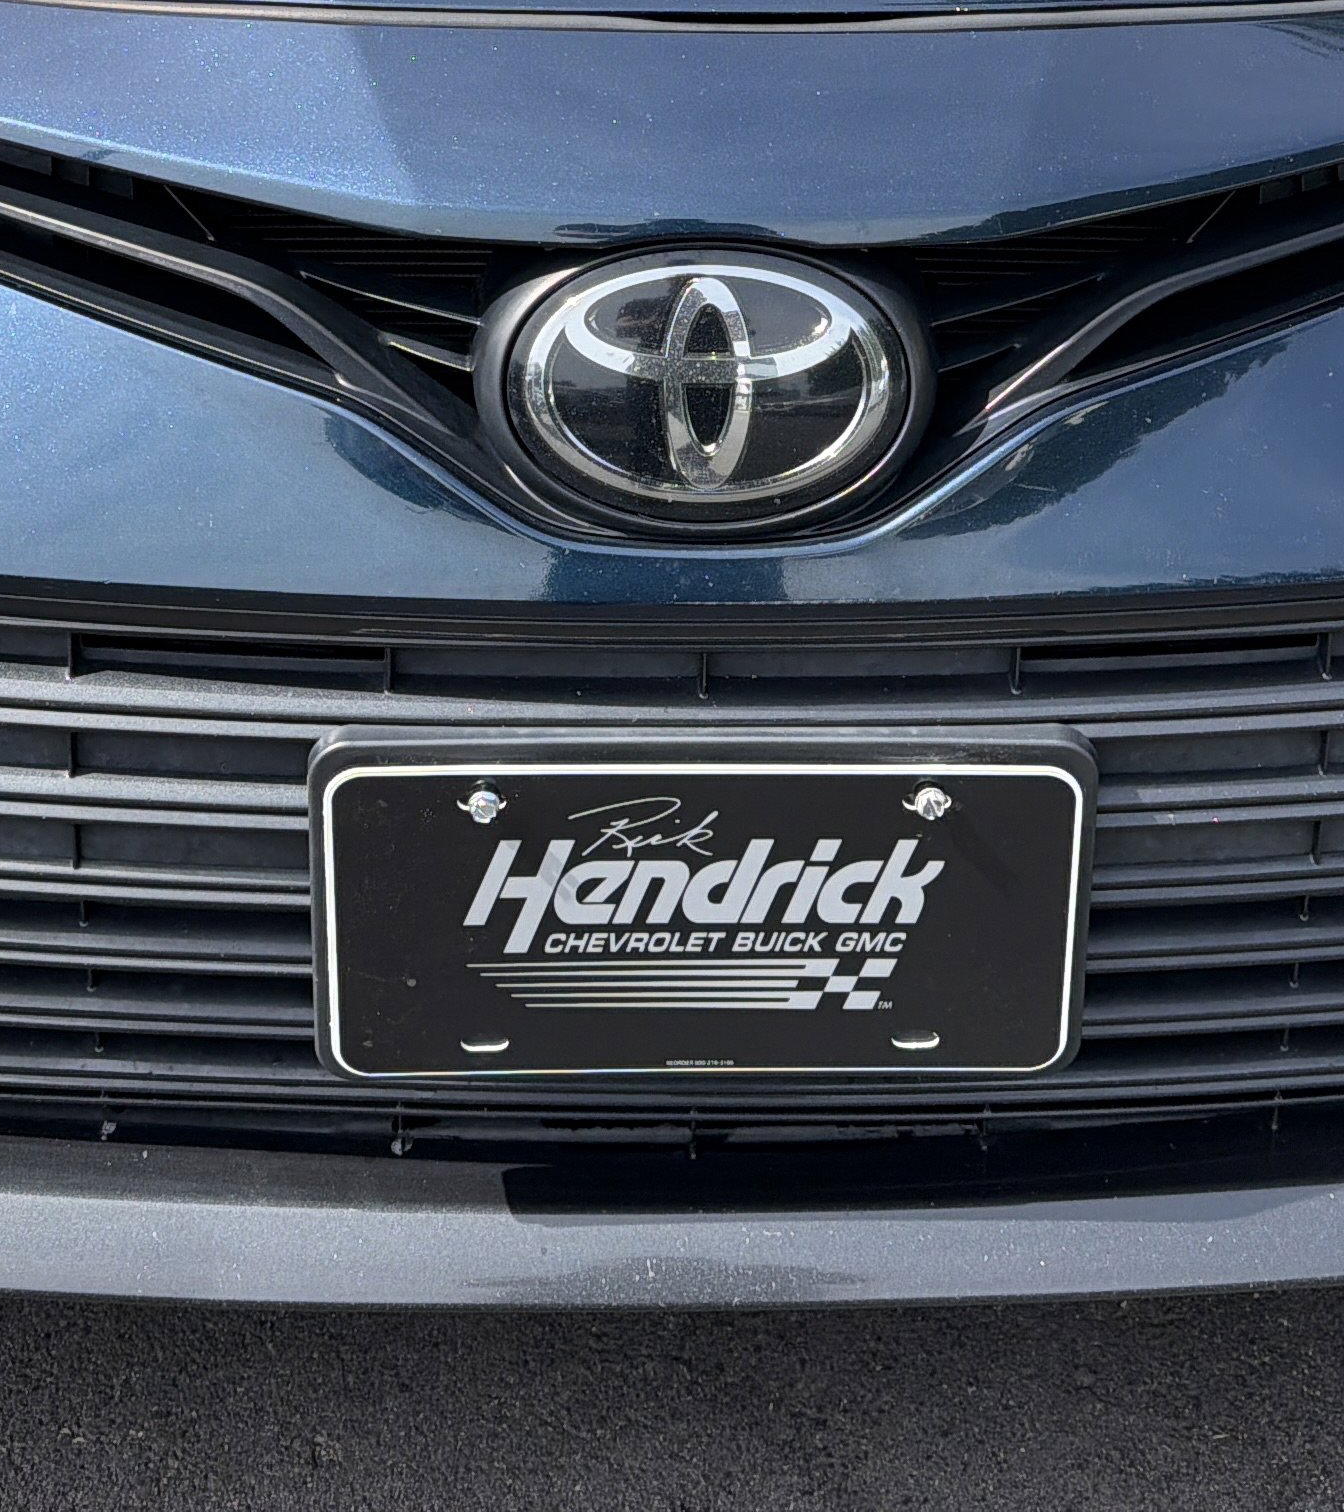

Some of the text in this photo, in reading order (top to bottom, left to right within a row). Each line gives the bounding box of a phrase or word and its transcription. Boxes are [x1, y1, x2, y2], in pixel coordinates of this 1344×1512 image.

[568, 796, 720, 857] Rick
[462, 838, 947, 955] Hendrick
[543, 931, 908, 954] CHEVROLET BUICK GMC
[878, 1000, 893, 1010] TM
